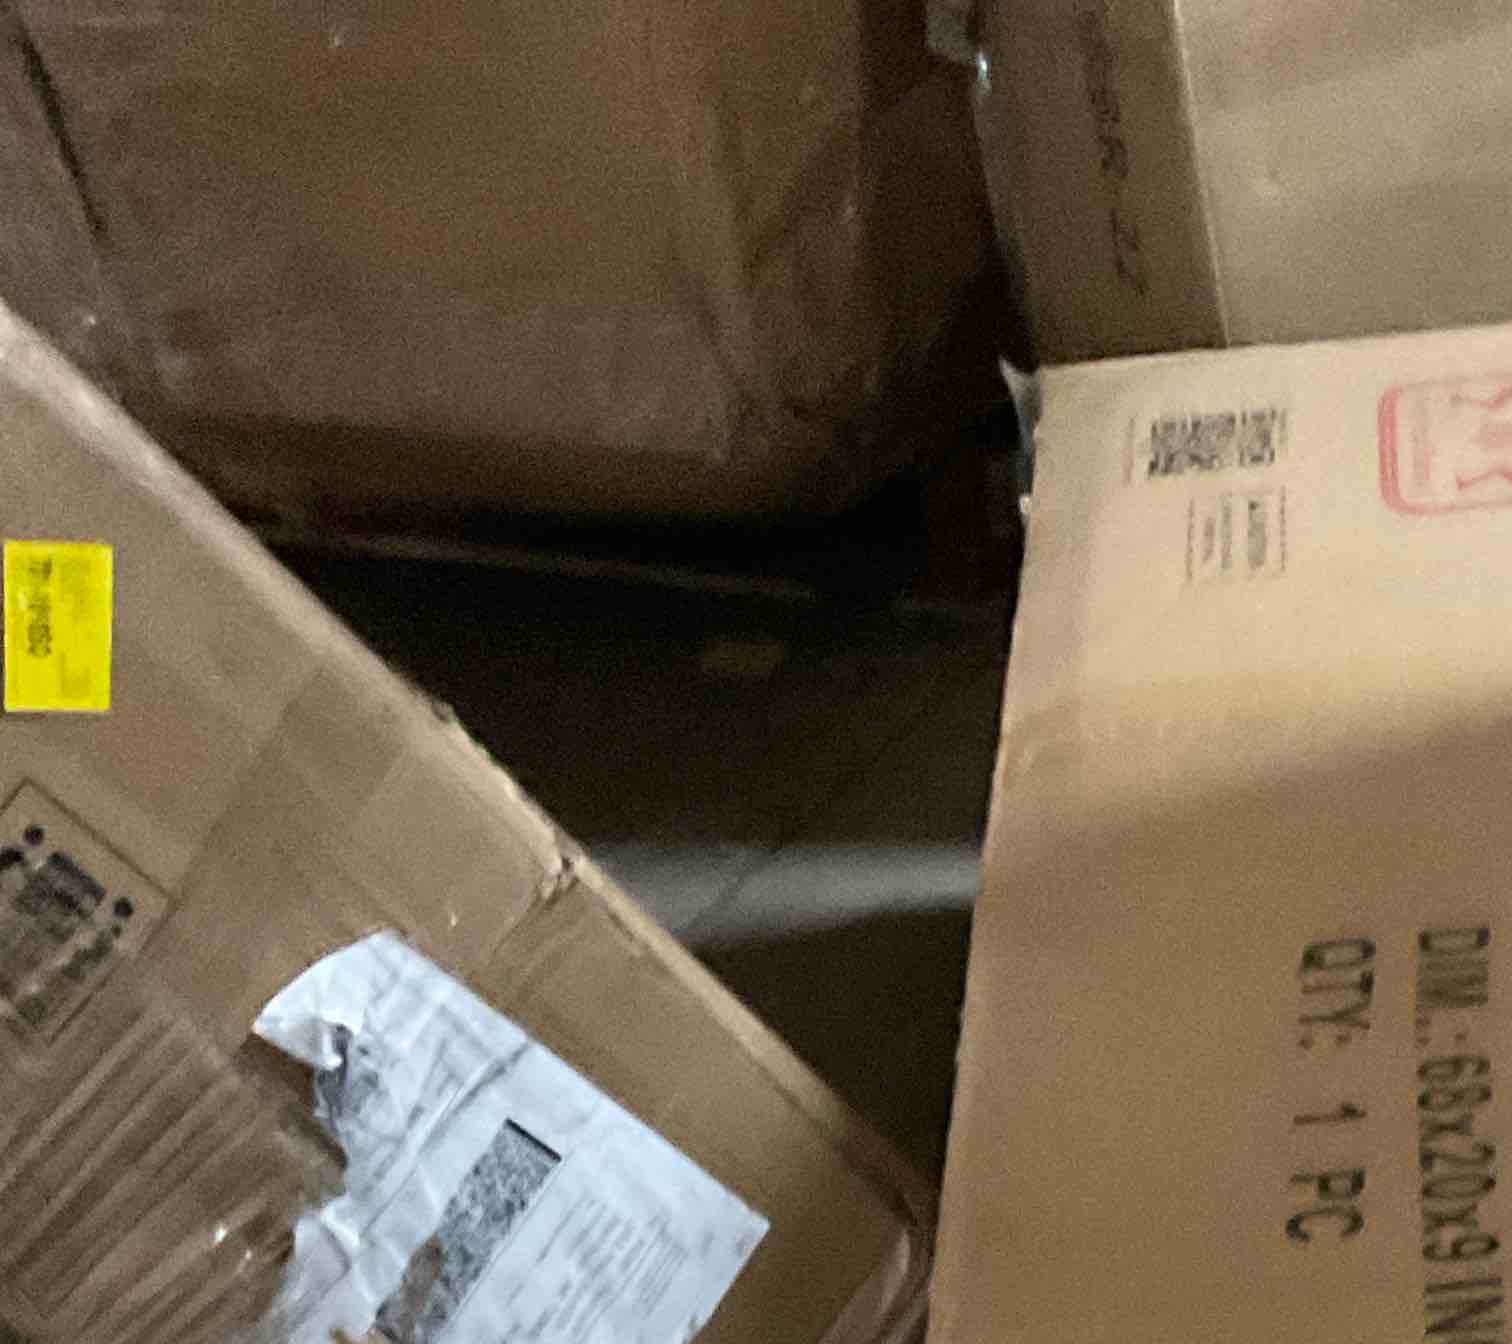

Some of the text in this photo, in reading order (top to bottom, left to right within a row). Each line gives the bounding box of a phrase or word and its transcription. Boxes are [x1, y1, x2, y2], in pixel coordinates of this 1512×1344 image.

[1285, 937, 1377, 1243] QTY: 1 PC
